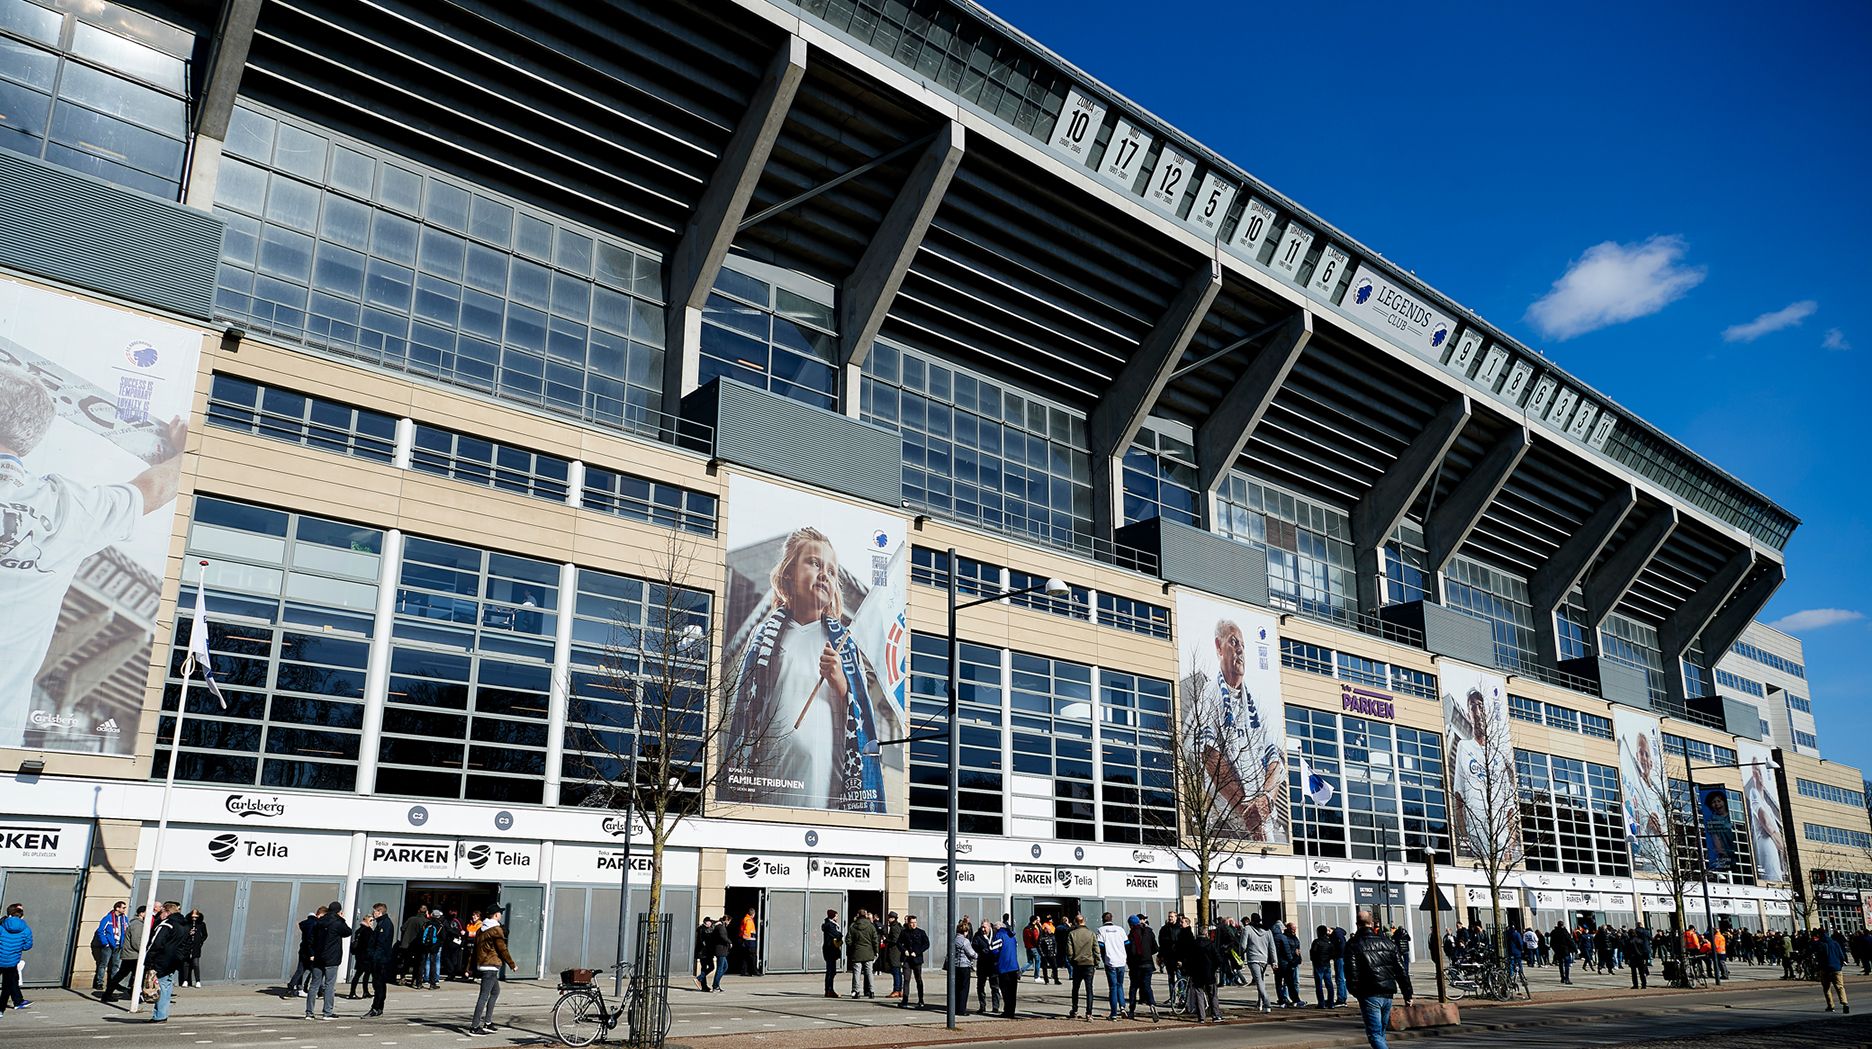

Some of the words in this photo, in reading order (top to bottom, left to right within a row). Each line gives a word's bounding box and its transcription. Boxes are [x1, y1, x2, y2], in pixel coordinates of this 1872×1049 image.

[1077, 96, 1094, 113] ZUMA
[1066, 110, 1090, 142] 10
[1115, 138, 1139, 170] 17
[1160, 164, 1182, 196] 12
[1204, 190, 1221, 218] 5
[1245, 214, 1264, 242] 10
[1285, 238, 1302, 264] 11
[1322, 261, 1336, 283] 6
[1377, 286, 1432, 327] LEGENDS
[1388, 314, 1408, 330] CLUB
[1460, 341, 1472, 360] 9
[1488, 357, 1498, 376] 1
[1512, 372, 1522, 390] 8
[1535, 385, 1546, 404] 6
[1557, 398, 1568, 416] 3
[1578, 410, 1588, 428] 3
[1596, 422, 1610, 440] 11
[1342, 693, 1394, 720] PARKEN
[30, 710, 80, 729] Carlsberg
[728, 775, 804, 790] FAMILIETRIBUNEN
[226, 794, 284, 818] Carlsberg
[244, 841, 288, 858] Telia
[373, 848, 448, 863] PARKEN
[495, 852, 530, 866] Telia
[764, 862, 790, 876] Telia
[824, 867, 870, 879] PARKEN
[1015, 874, 1052, 884] PARKEN
[1074, 875, 1092, 886] Telia
[1126, 879, 1158, 888] PARKEN
[1214, 881, 1229, 890] Telia
[1320, 886, 1332, 894] Telia
